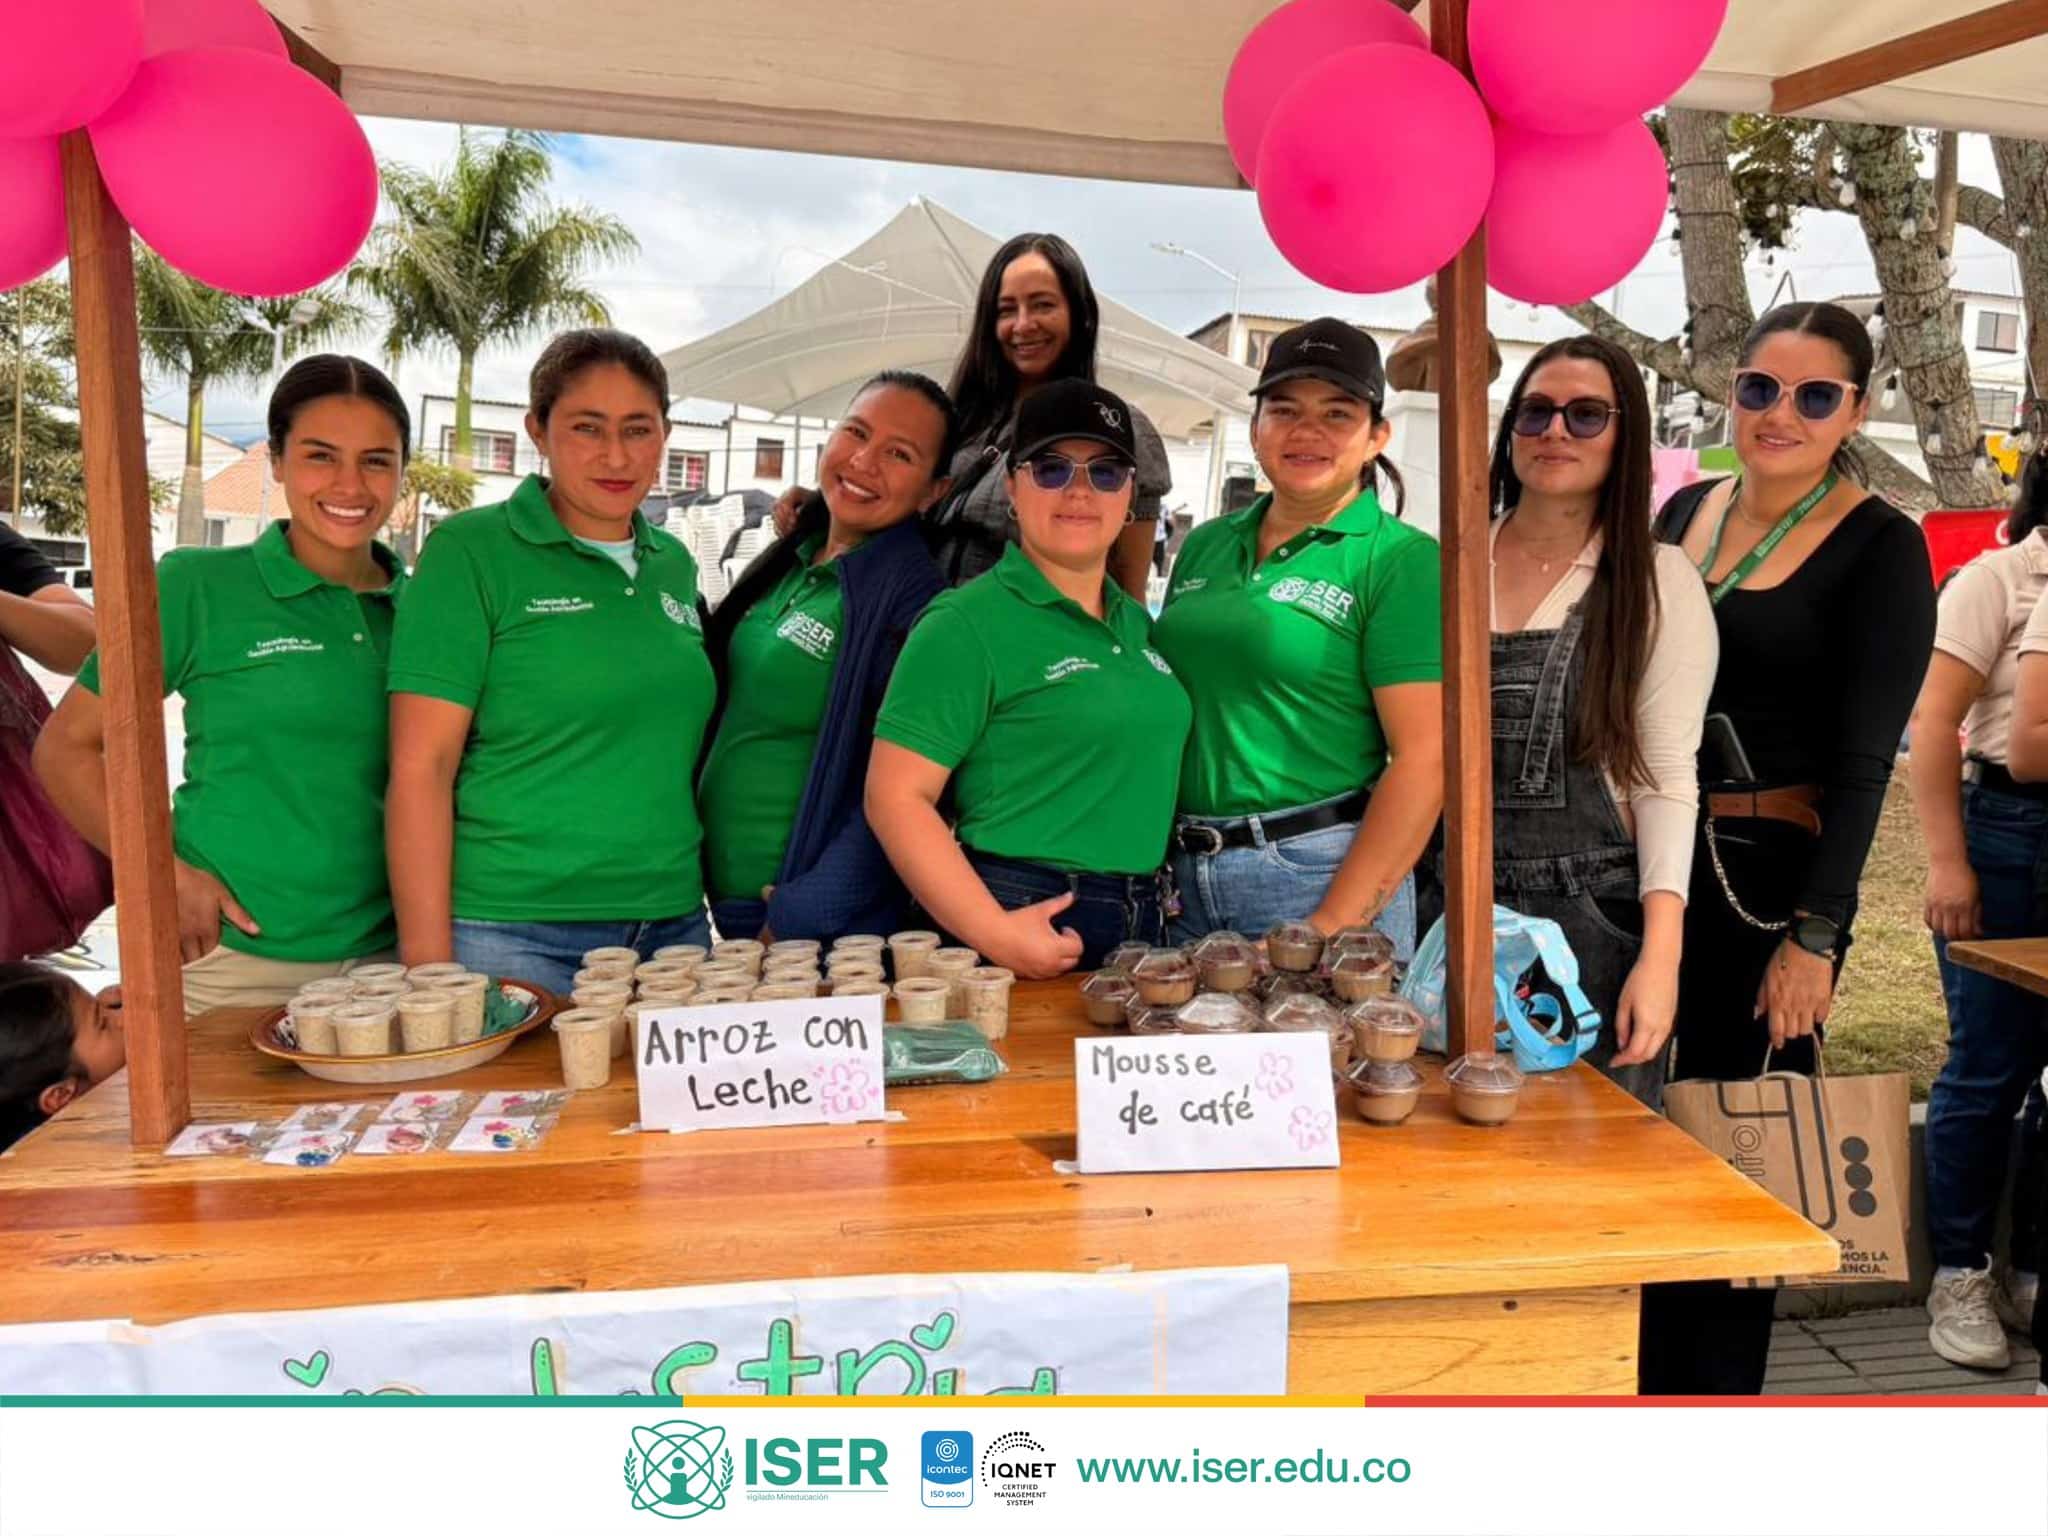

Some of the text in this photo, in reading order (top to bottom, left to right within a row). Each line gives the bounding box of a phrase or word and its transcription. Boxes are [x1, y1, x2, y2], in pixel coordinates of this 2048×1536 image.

[643, 1015, 868, 1066] Arroz con
[1092, 1044, 1217, 1084] Mousse
[687, 1067, 813, 1112] Leche
[1119, 1083, 1255, 1135] de café
[1871, 1251, 1889, 1261] LA
